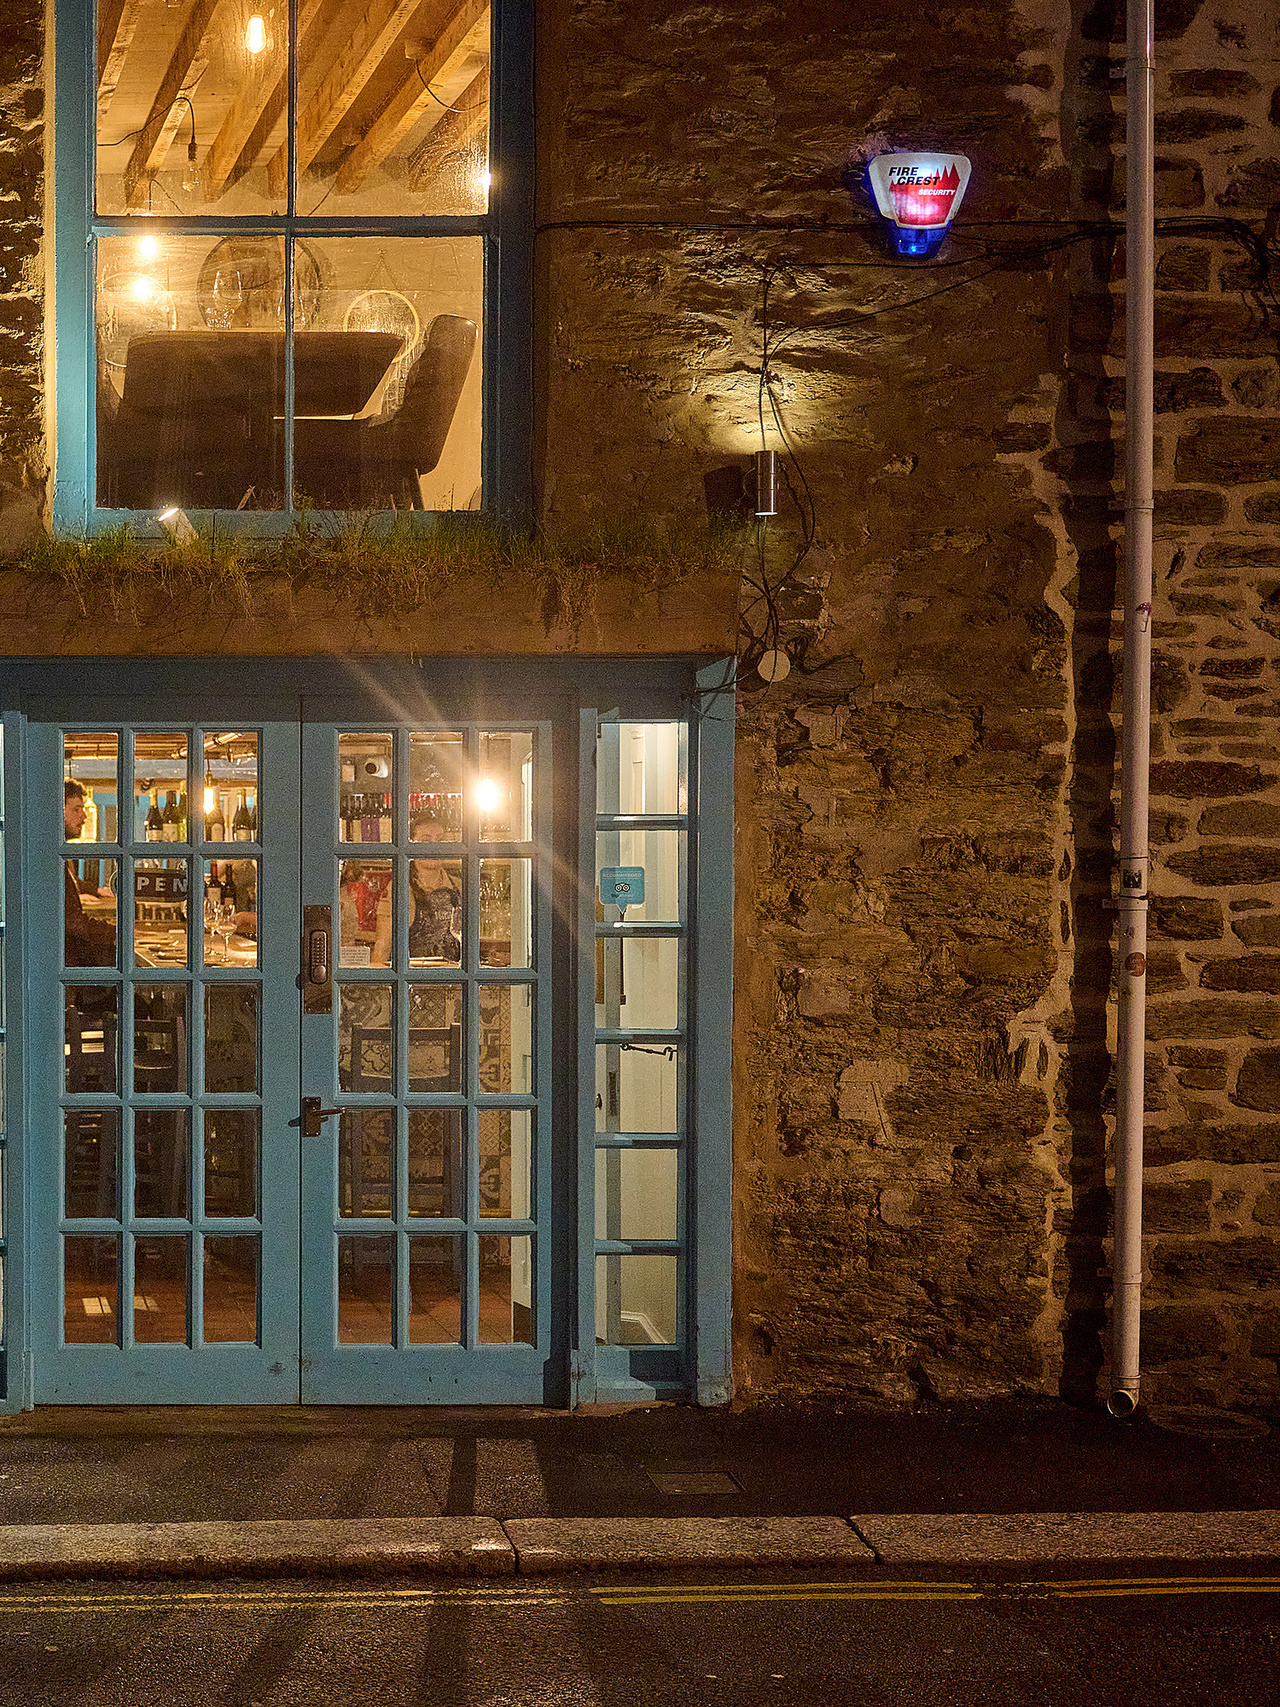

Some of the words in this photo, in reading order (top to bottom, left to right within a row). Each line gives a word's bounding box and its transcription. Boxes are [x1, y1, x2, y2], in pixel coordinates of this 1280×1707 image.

[888, 167, 919, 177] FIRE
[897, 177, 940, 186] CREST
[137, 876, 187, 892] PEN
